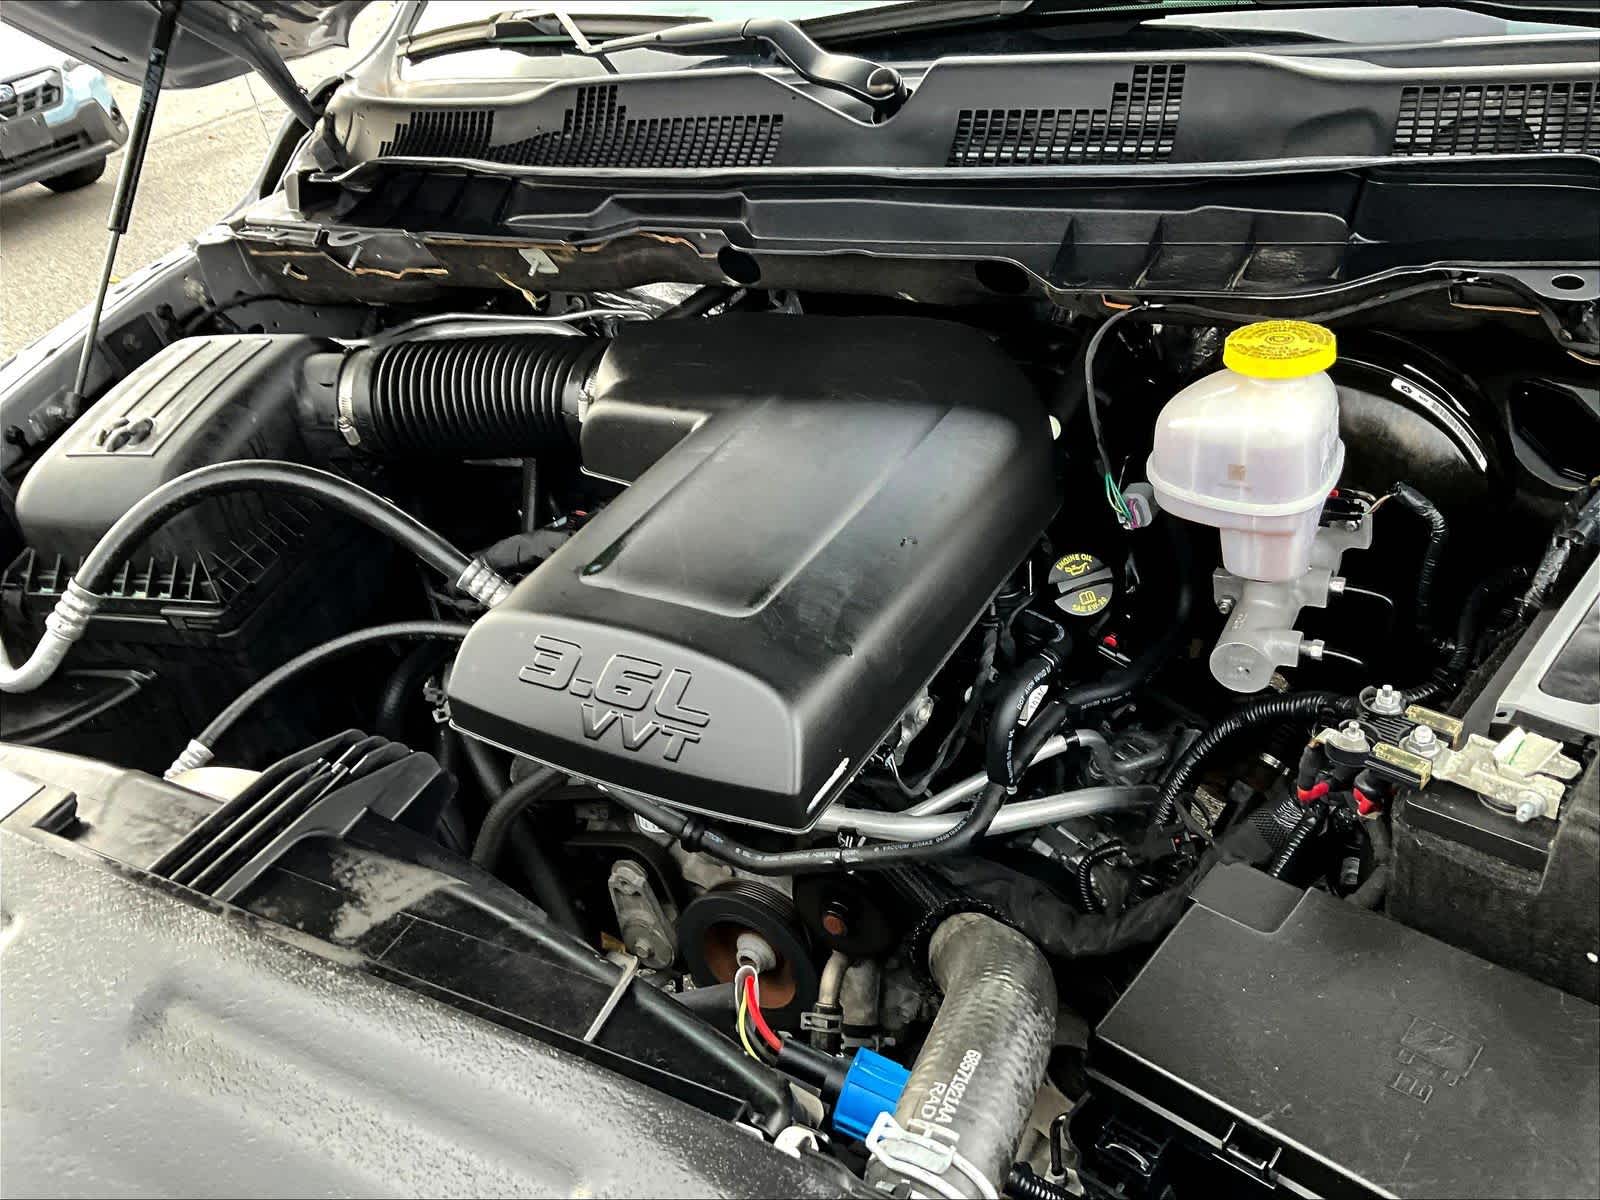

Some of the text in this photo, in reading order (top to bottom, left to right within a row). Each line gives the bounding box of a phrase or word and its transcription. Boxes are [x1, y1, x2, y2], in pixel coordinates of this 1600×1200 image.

[1055, 553, 1093, 570] ENGINE OIL
[518, 633, 711, 728] 3.6L
[581, 702, 702, 763] VVT
[921, 1081, 947, 1120] RAD
